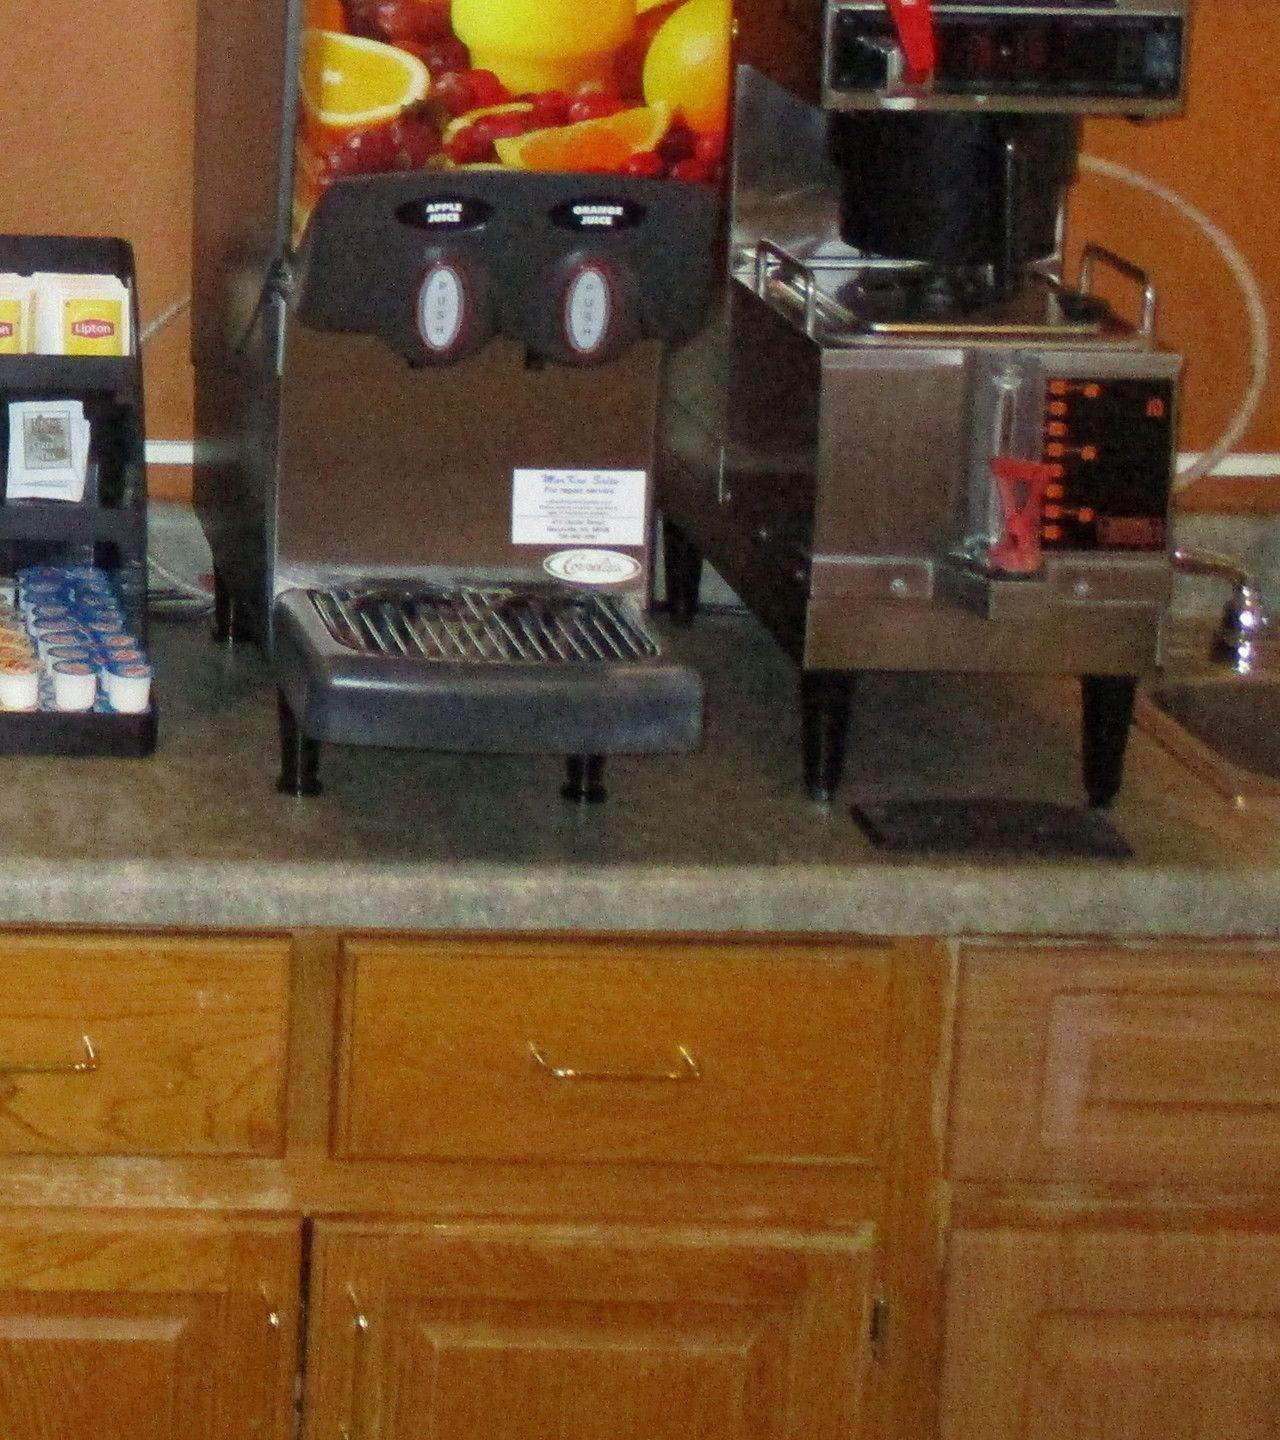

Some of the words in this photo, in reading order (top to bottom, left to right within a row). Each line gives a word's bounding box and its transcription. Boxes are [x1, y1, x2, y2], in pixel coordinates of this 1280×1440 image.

[425, 202, 462, 213] APPLE
[572, 205, 624, 216] ORANGE
[427, 213, 461, 223] JUICE
[579, 216, 614, 226] JUICE
[74, 322, 112, 335] Lipton
